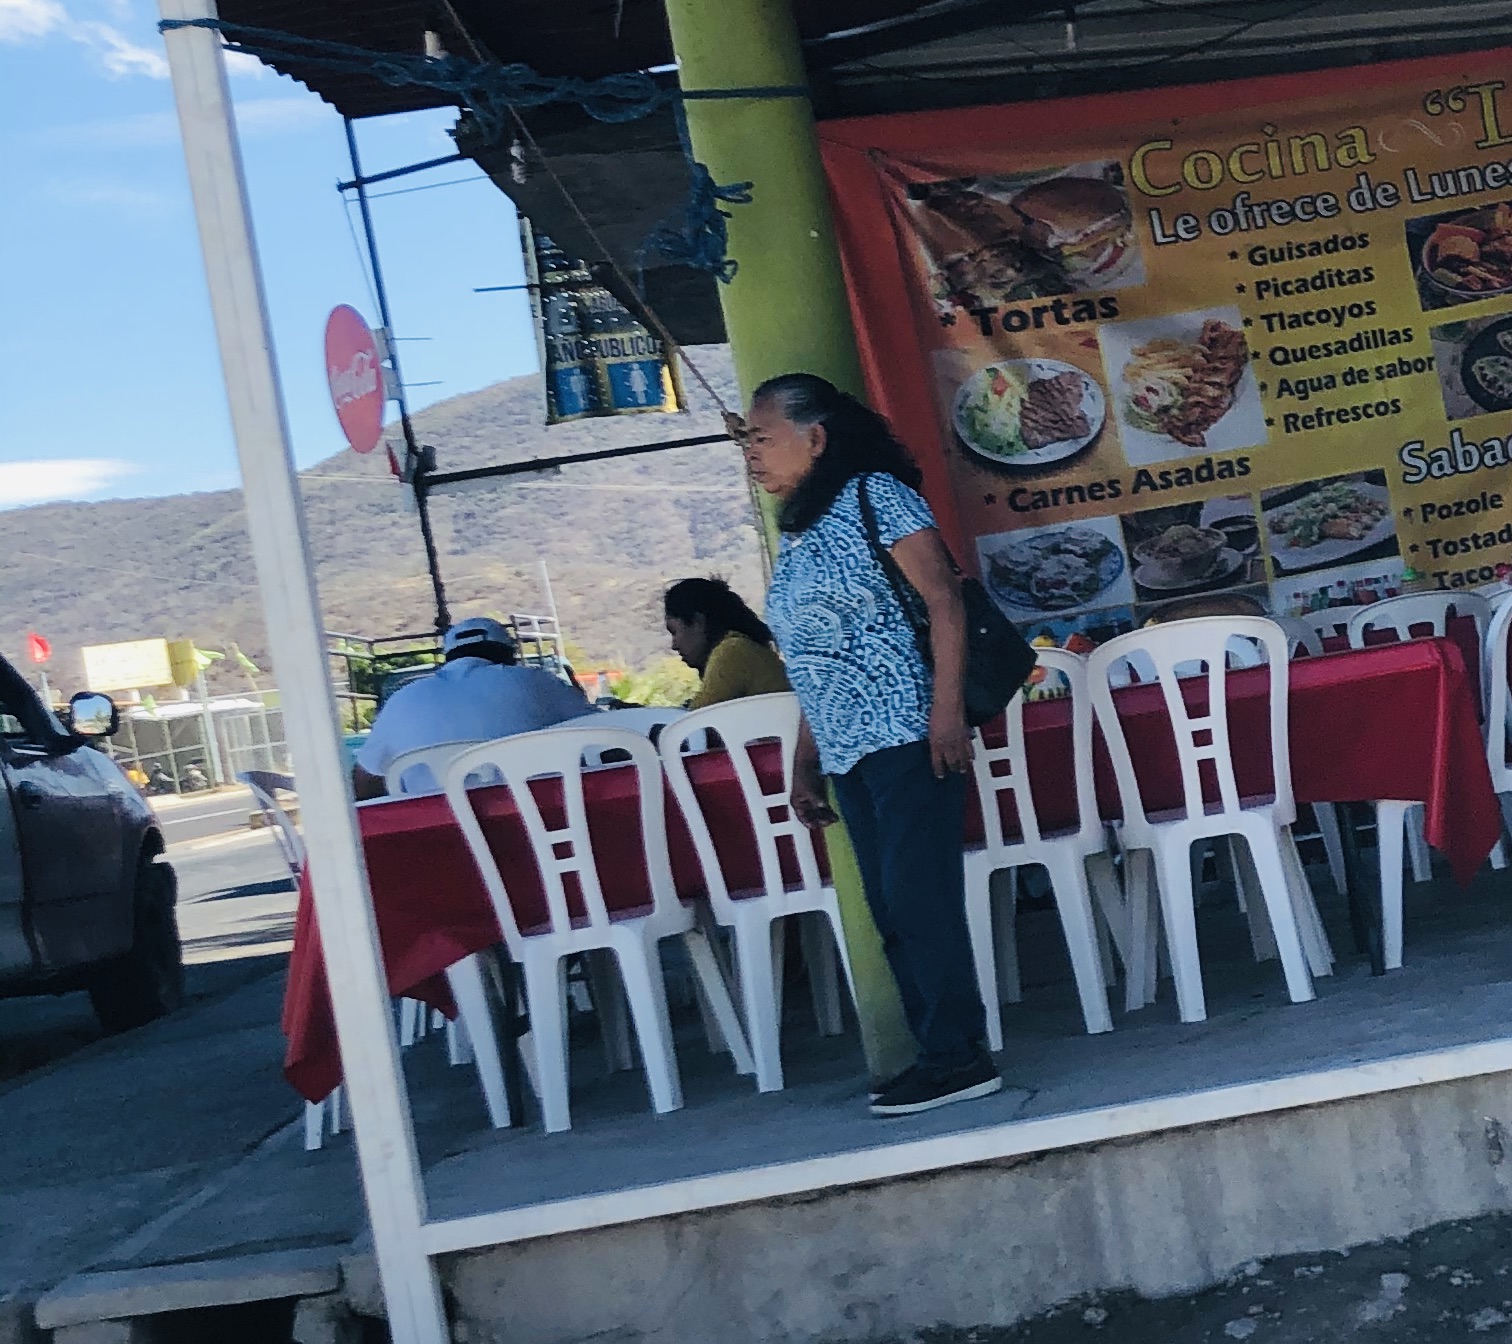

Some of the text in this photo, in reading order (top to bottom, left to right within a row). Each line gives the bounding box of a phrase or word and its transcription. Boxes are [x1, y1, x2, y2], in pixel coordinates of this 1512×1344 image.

[1129, 122, 1377, 198] Cocina
[1149, 209, 1199, 245] Le
[1209, 191, 1340, 237] ofrece
[1348, 171, 1400, 213] de
[1247, 229, 1370, 267] Guisados
[1256, 263, 1375, 299] Picaditas
[971, 295, 1119, 337] Tortas
[1261, 297, 1377, 334] Tlacoyos
[1269, 324, 1414, 367] Quesadillas
[1277, 354, 1435, 401] Agua de sabor
[1283, 397, 1401, 434] Refrescos
[1008, 456, 1250, 513] Carnes Asadas
[1421, 491, 1503, 524] Pozole
